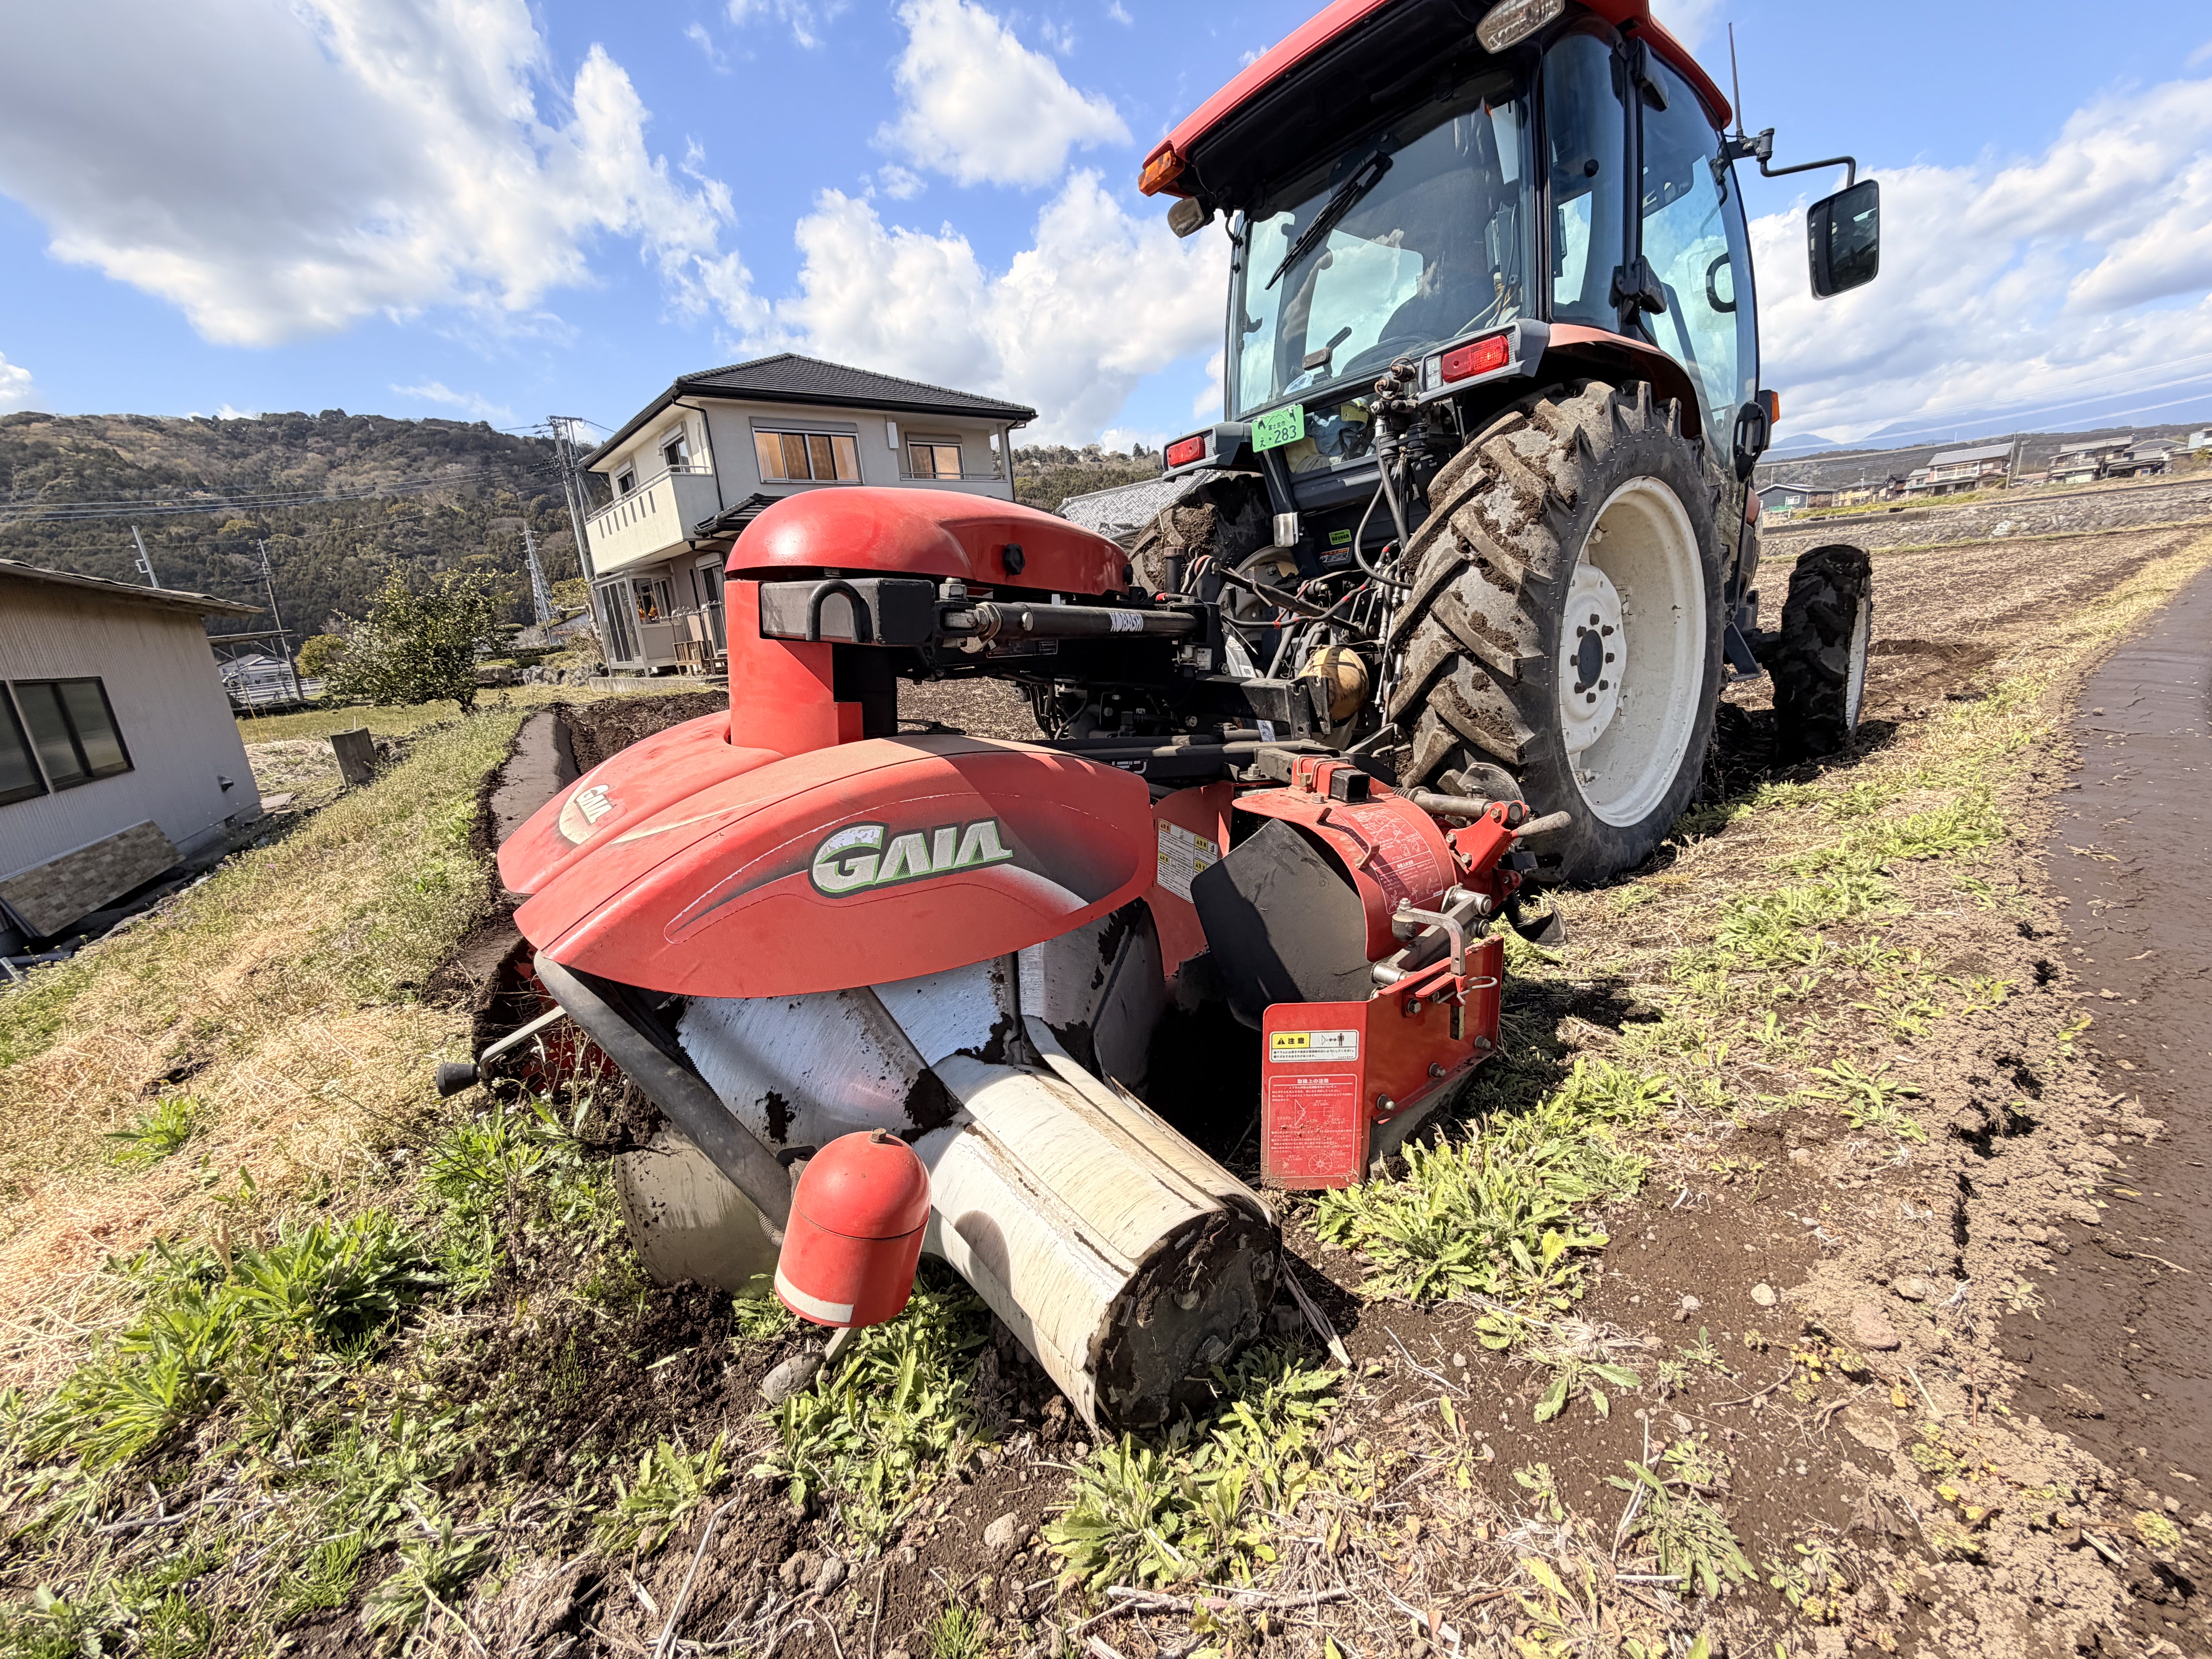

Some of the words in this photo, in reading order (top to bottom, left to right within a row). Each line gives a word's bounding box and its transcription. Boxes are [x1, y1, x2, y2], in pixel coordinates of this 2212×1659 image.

[1268, 421, 1286, 431] 富士宮市
[1260, 437, 1266, 447] え
[1109, 612, 1144, 632] KOBASHI
[576, 784, 613, 825] GAIA
[811, 821, 1014, 894] GAIA
